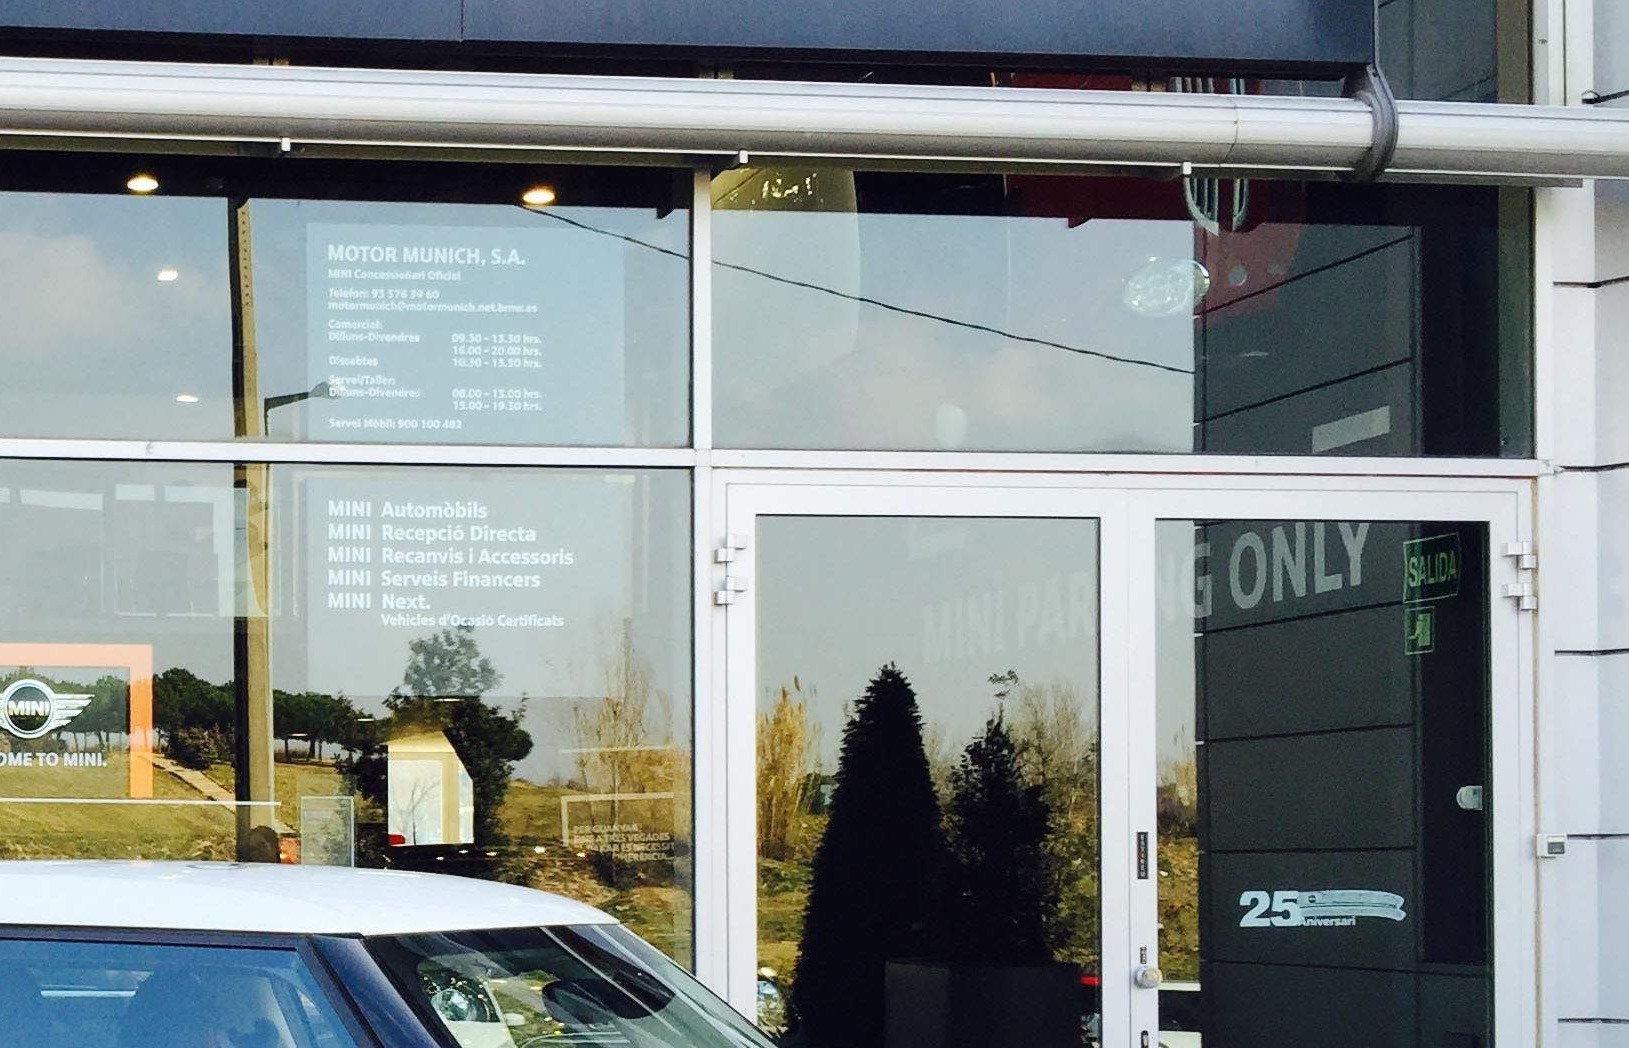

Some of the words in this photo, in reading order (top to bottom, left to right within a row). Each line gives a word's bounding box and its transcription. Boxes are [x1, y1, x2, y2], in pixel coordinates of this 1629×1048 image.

[327, 244, 397, 263] MOTOR
[402, 246, 486, 266] MUNICH,
[490, 248, 526, 265] S.A.
[327, 268, 352, 279] MINI
[427, 270, 462, 282] Oficial
[371, 289, 384, 299] 93
[327, 500, 371, 517] MINI
[380, 500, 488, 519] Automòbils
[327, 523, 371, 540] MINI
[381, 524, 465, 544] Recepció
[471, 525, 537, 542] Directa
[327, 546, 371, 563] MINI
[381, 547, 464, 564] Recanvis
[468, 548, 473, 564] i
[477, 548, 575, 566] Accessoris
[1229, 522, 1370, 610] ONLY
[1407, 548, 1459, 588] SALIDA
[327, 569, 371, 586] MINI
[380, 570, 448, 587] Serveis
[452, 571, 541, 588] Financers
[327, 592, 371, 609] MINI
[381, 593, 431, 610] Next.
[381, 613, 435, 626] Vehicles
[497, 614, 565, 628] Certificats
[7, 700, 50, 716] MINI
[36, 752, 59, 766] TO
[63, 752, 108, 768] MINI.
[1239, 890, 1301, 928] 25
